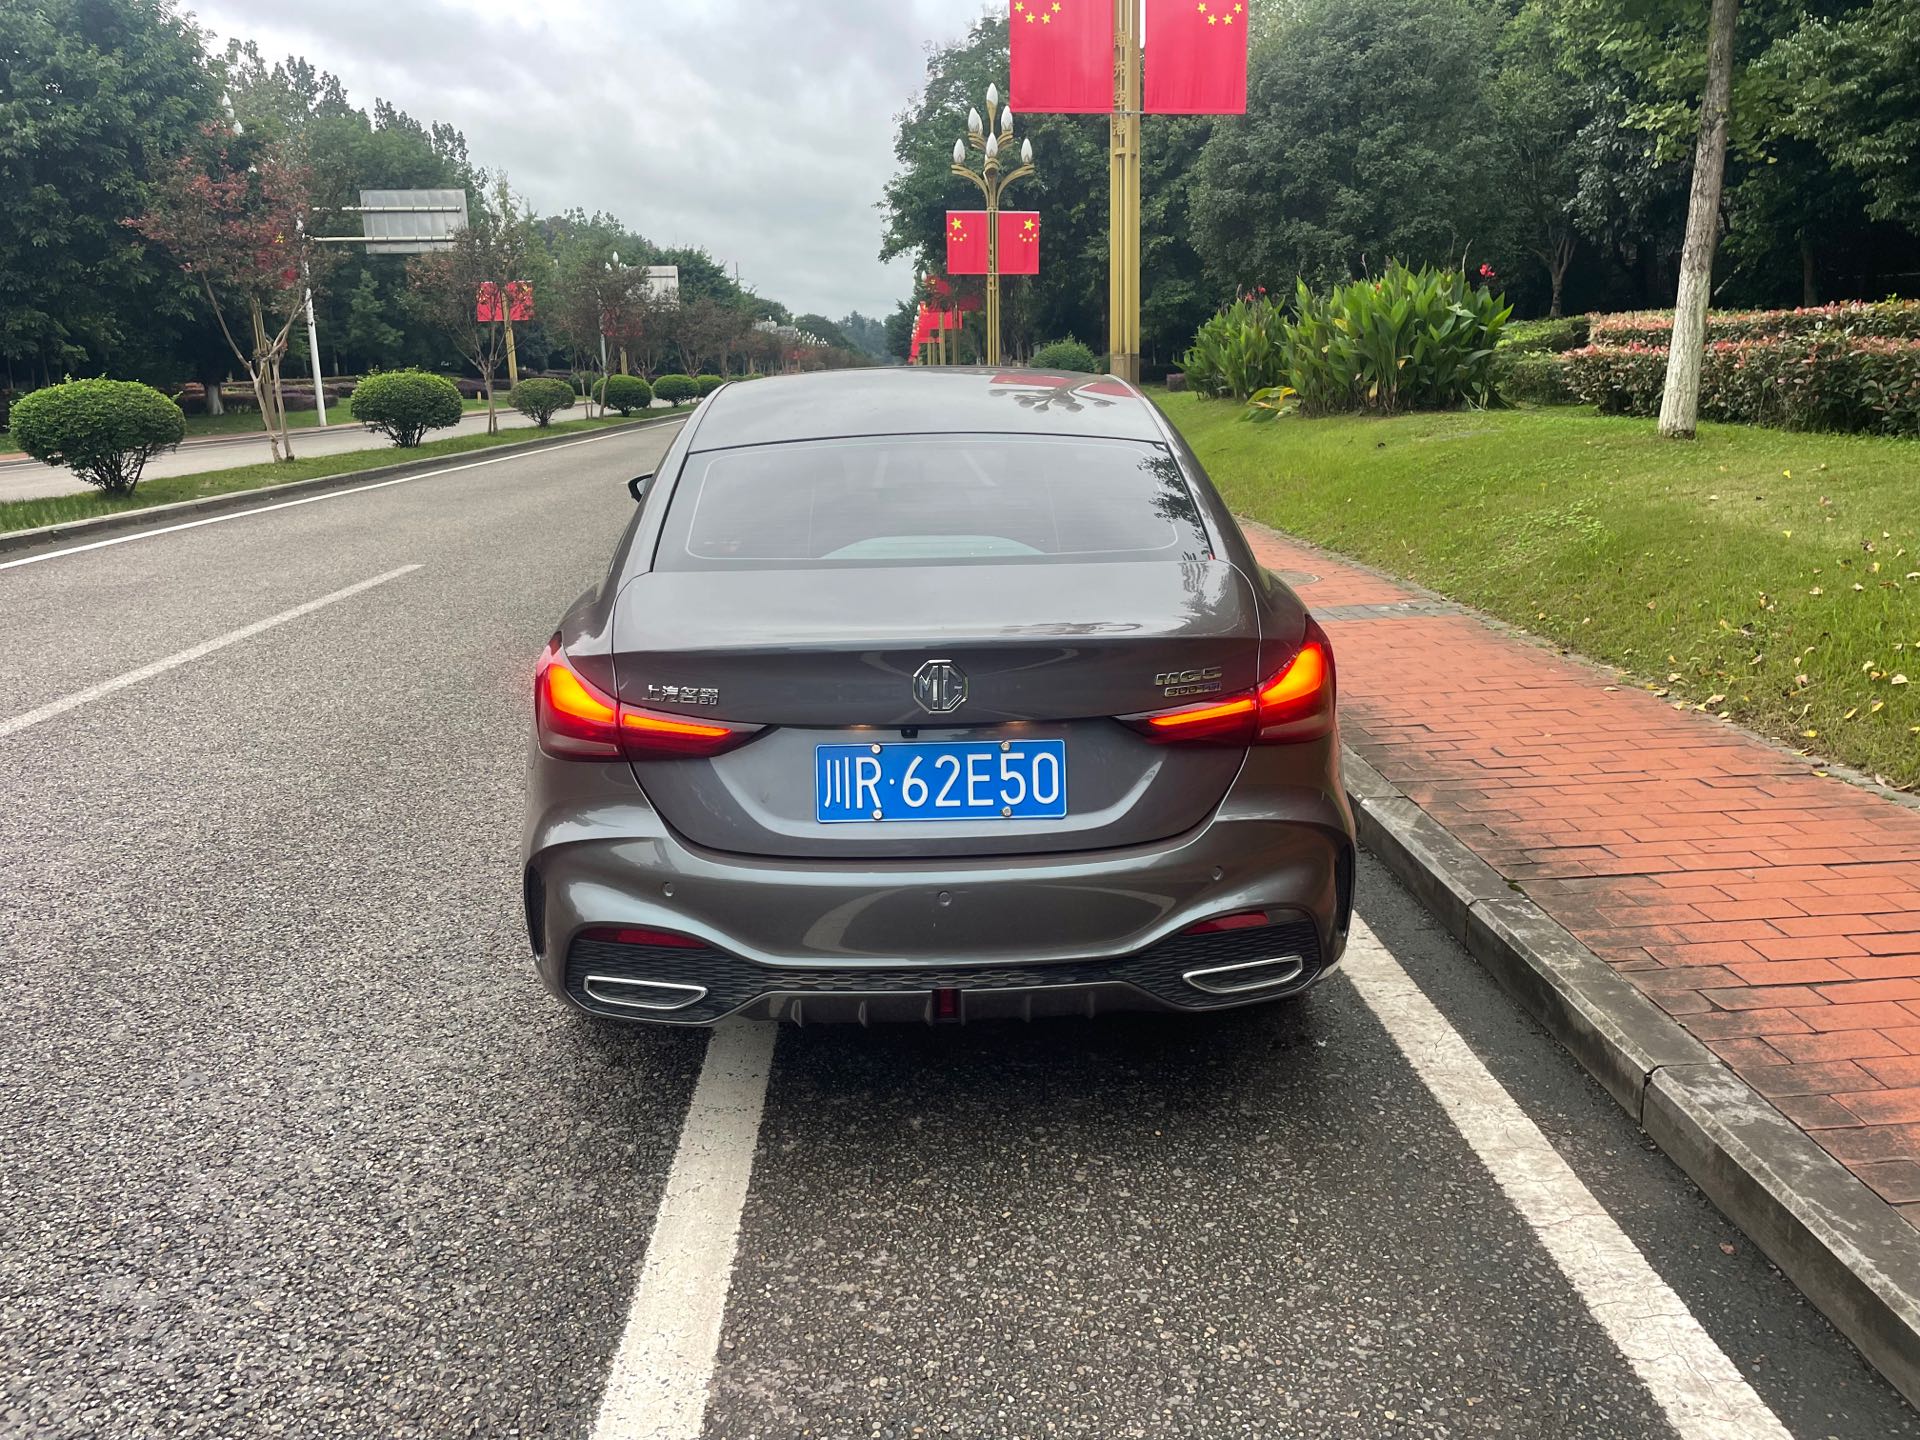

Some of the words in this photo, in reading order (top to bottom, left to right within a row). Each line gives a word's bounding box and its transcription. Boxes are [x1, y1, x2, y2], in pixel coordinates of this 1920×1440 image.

[917, 663, 965, 711] MG
[1155, 666, 1223, 686] MG5
[643, 684, 719, 706] 上汽名爵
